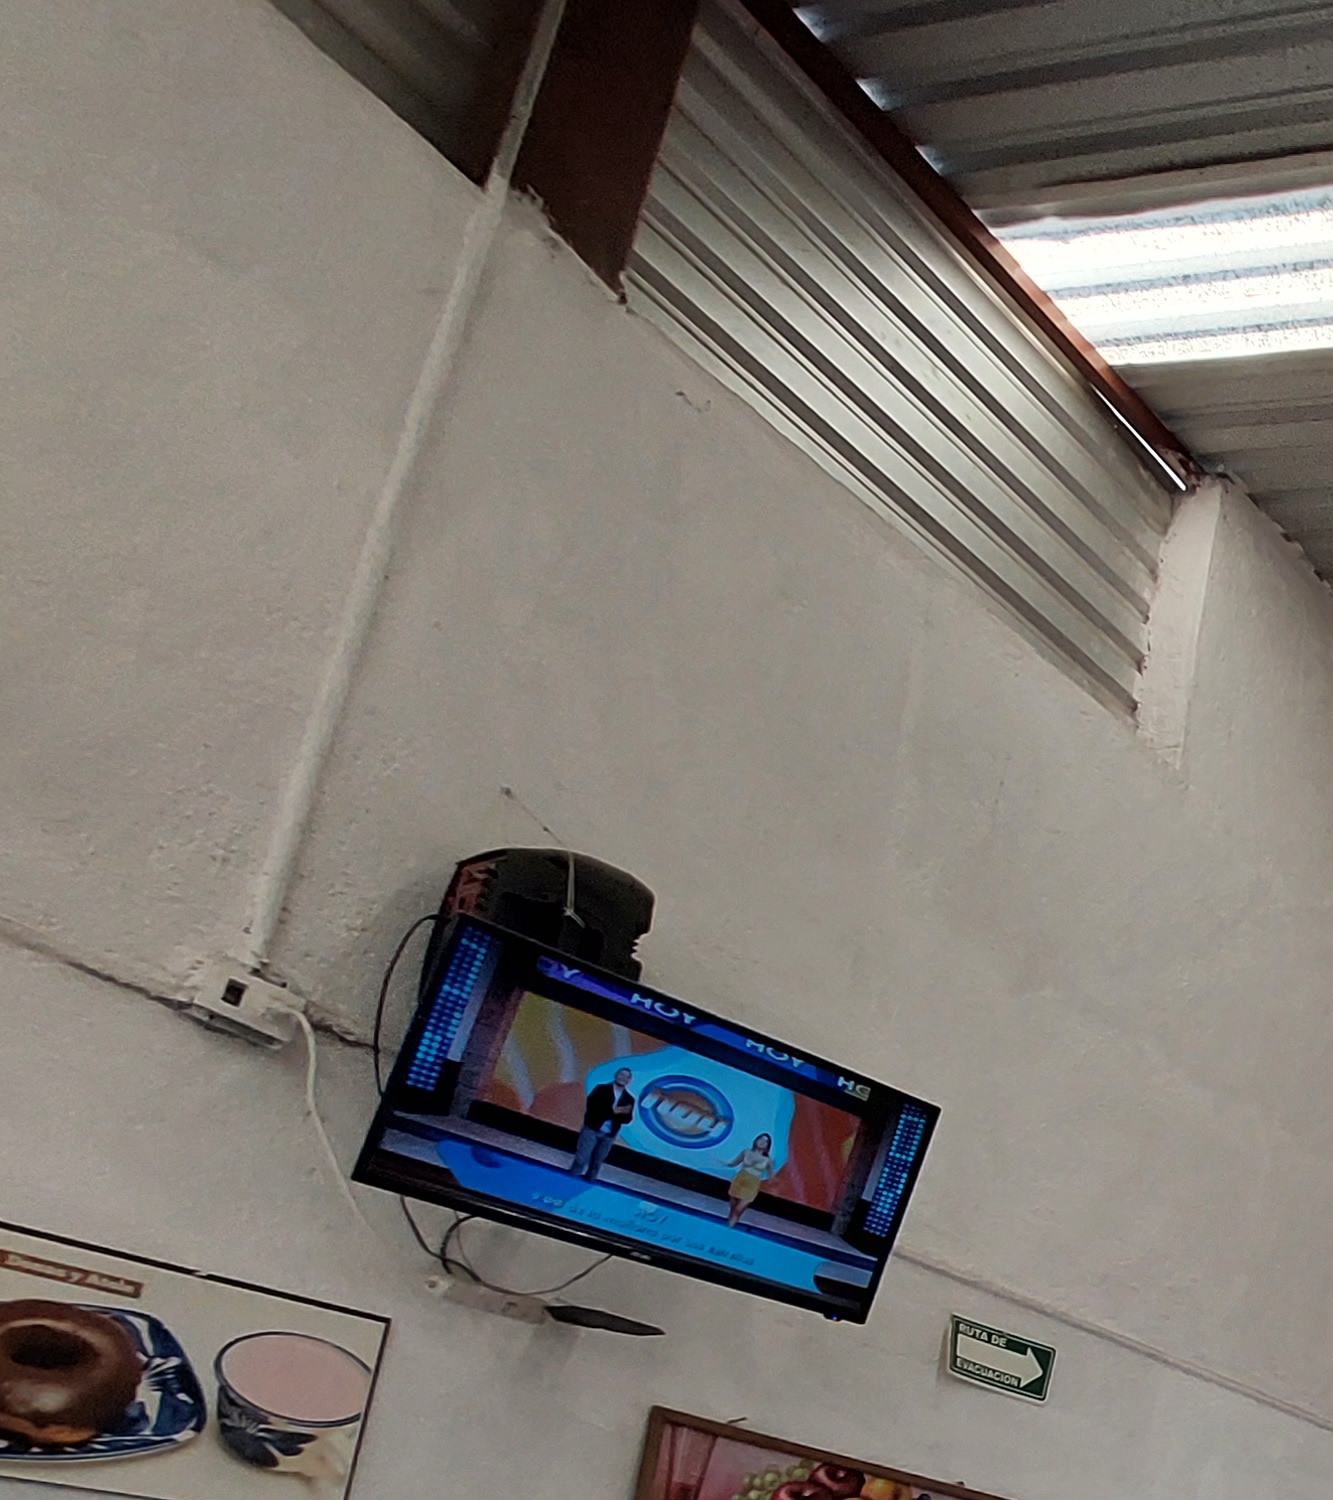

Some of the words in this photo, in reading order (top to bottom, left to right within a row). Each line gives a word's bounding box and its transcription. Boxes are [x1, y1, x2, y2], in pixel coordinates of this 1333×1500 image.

[631, 993, 697, 1025] HOY
[745, 1039, 805, 1068] HOY
[959, 1323, 988, 1342] RUTA
[991, 1334, 1007, 1347] DE
[956, 1357, 1019, 1387] EVACUACION
